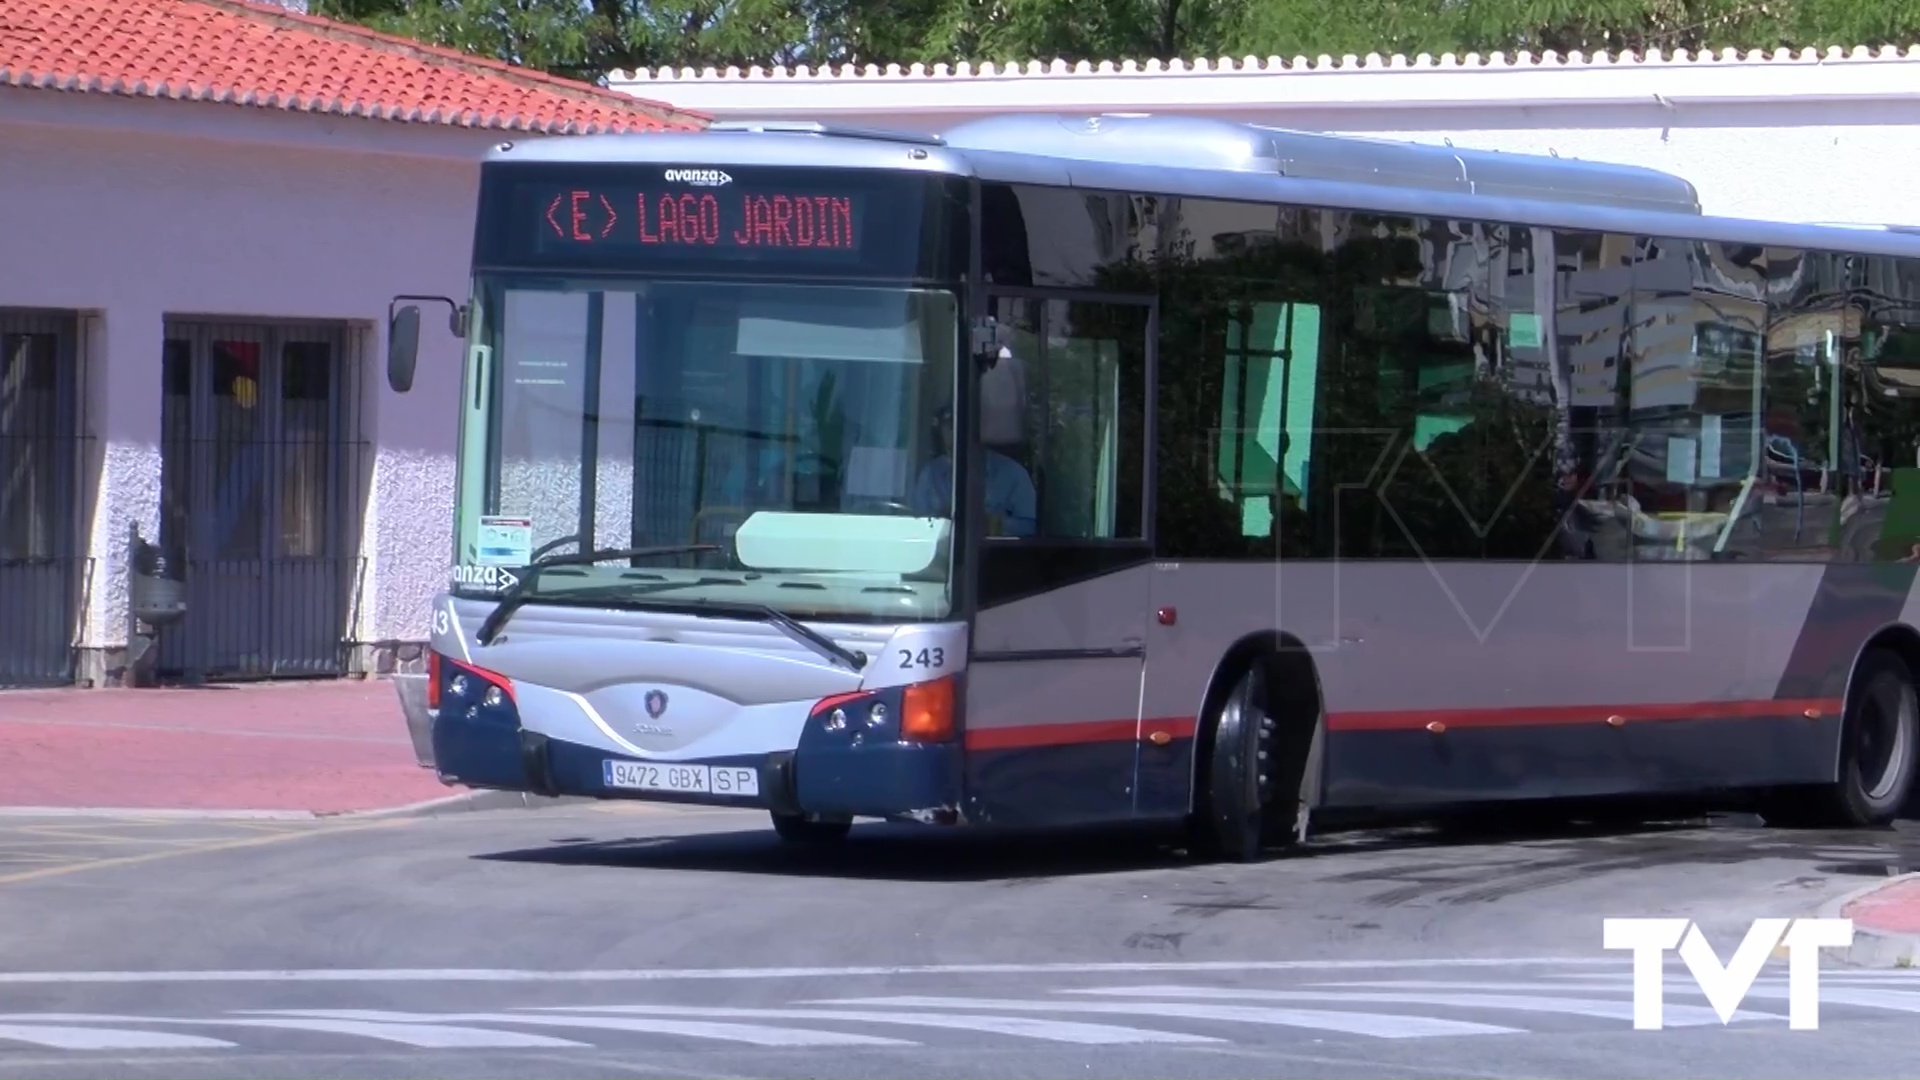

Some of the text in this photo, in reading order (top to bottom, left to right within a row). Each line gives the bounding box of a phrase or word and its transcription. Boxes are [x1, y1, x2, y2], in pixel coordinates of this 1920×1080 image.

[665, 169, 718, 182] avanza
[638, 193, 719, 244] LAGO
[734, 194, 851, 247] JARDIN
[898, 647, 945, 669] 243
[616, 765, 659, 786] 9472
[668, 768, 703, 788] GBX
